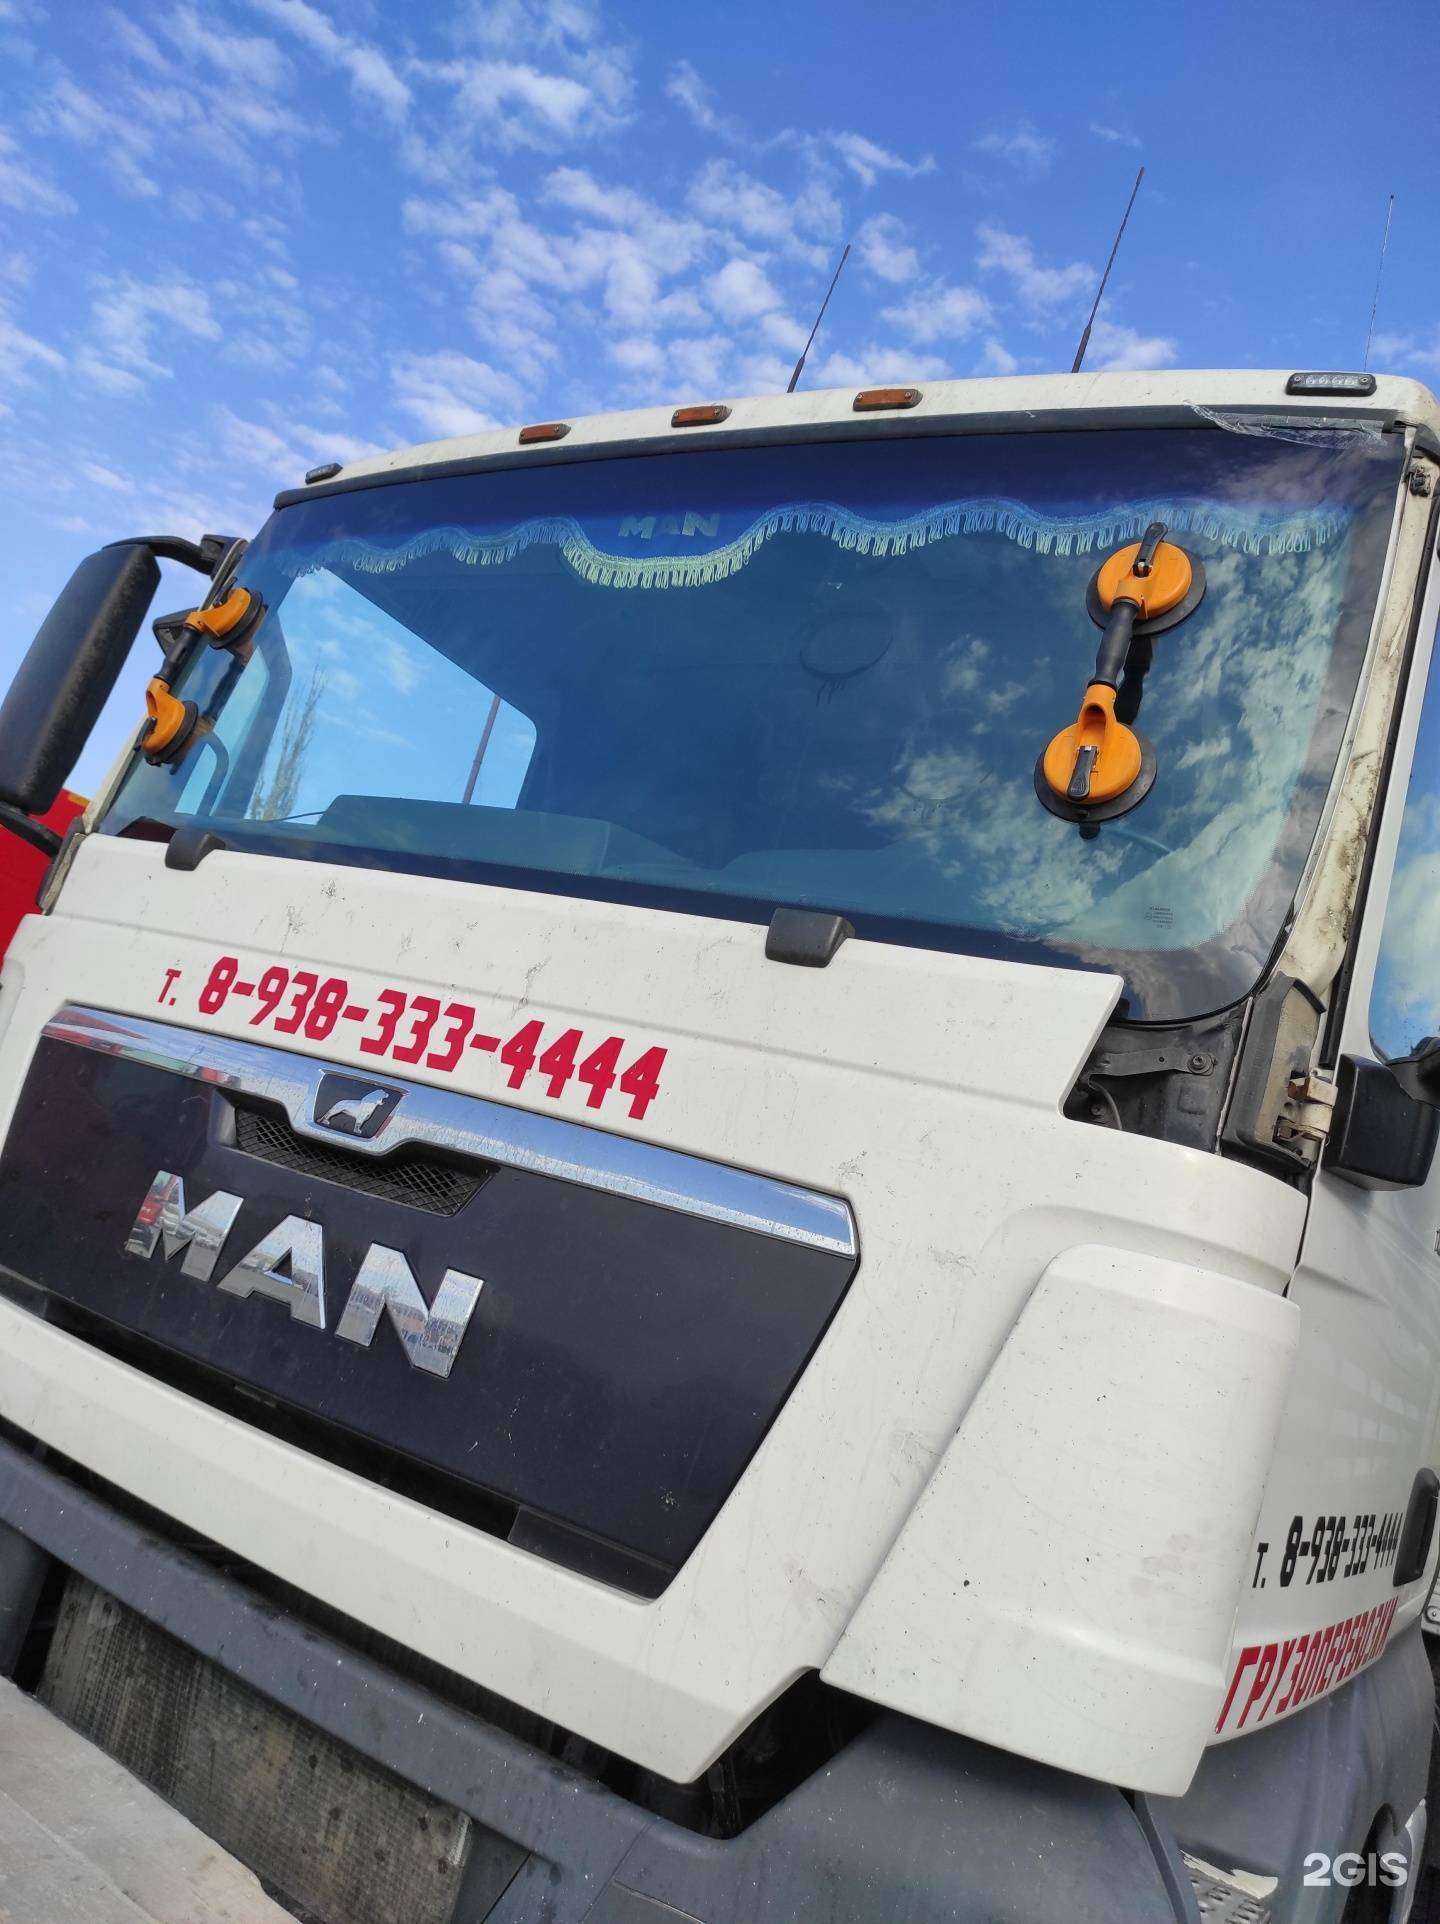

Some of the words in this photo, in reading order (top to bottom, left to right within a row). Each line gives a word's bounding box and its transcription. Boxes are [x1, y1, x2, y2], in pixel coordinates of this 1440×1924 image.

[618, 511, 720, 539] MAN
[198, 956, 668, 1120] 8-938-333-4444
[124, 1170, 485, 1380] MAN
[1280, 1512, 1403, 1587] 8-938-333-4444
[1215, 1597, 1398, 1734] ГРУЗОПЕРЕВОЗКИ
